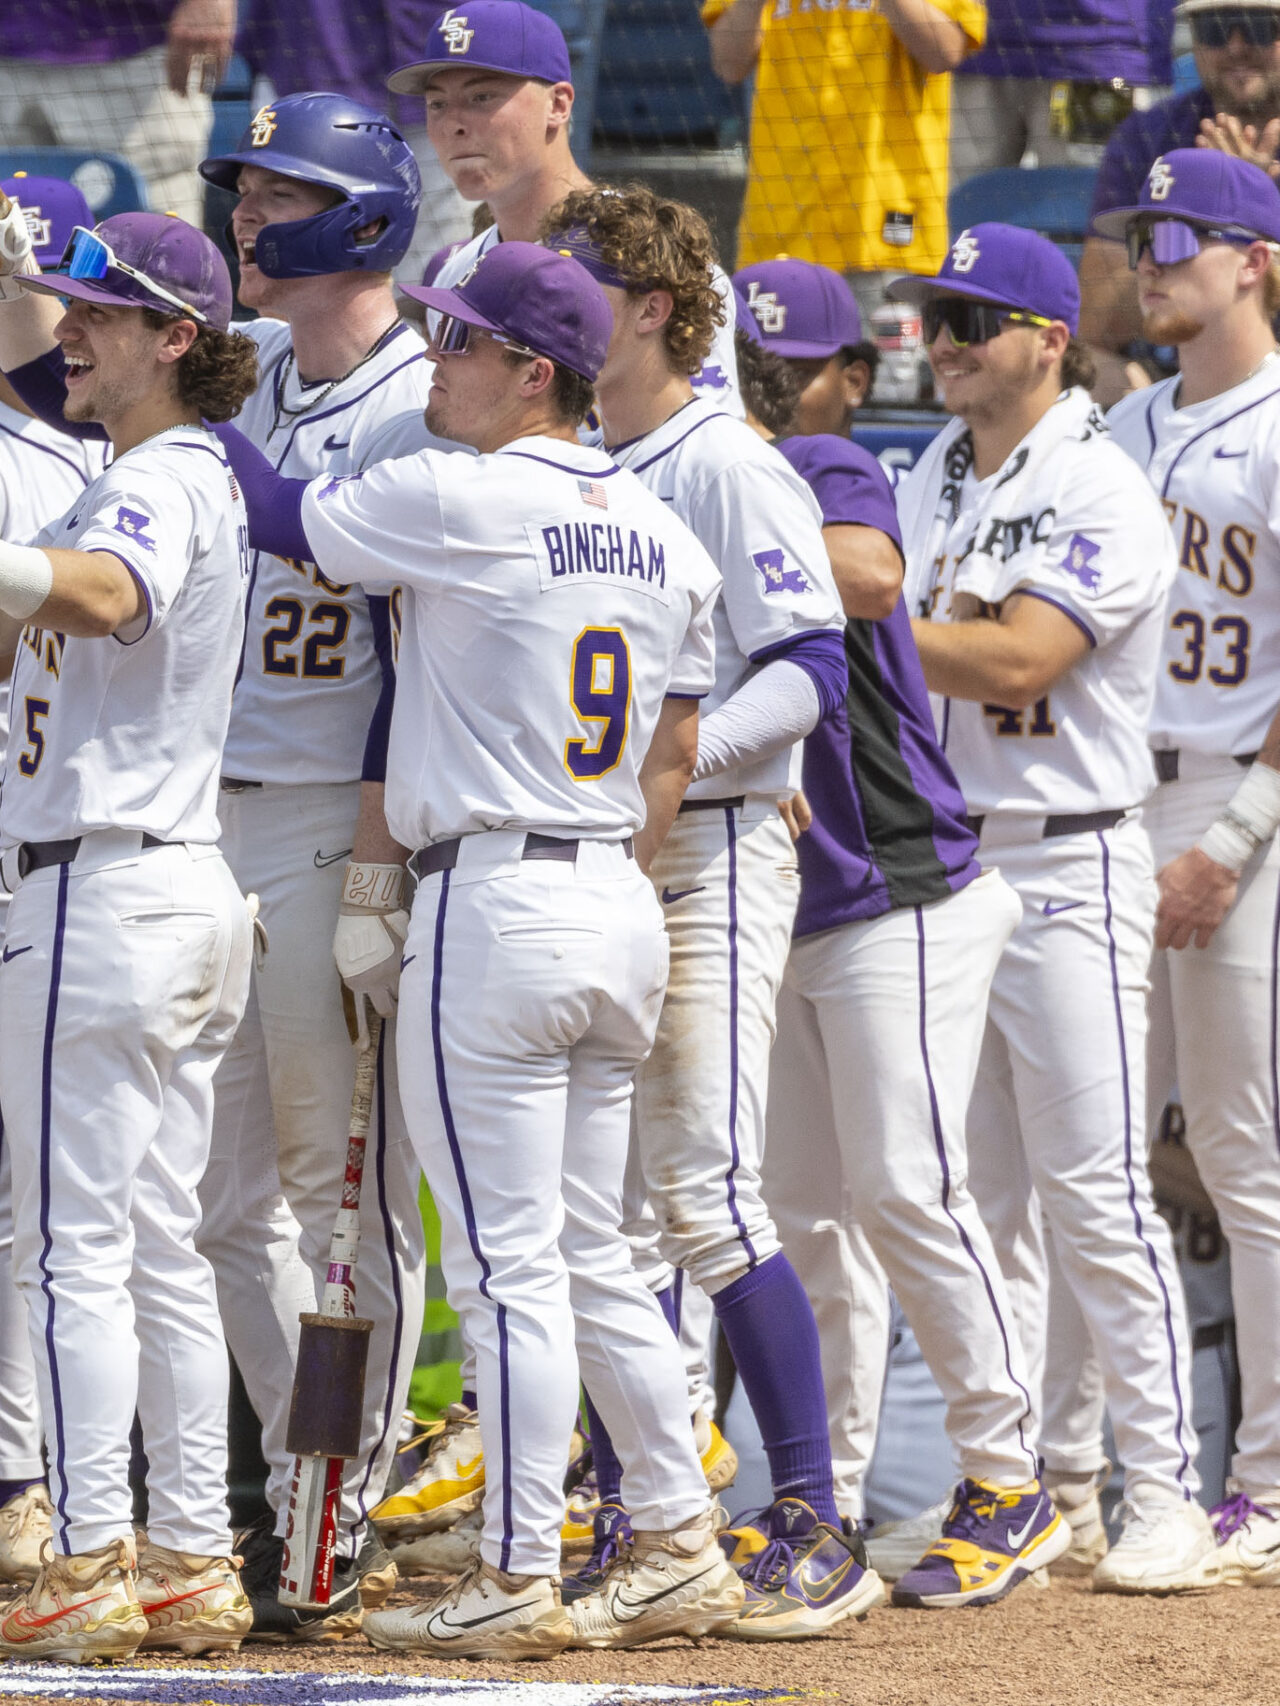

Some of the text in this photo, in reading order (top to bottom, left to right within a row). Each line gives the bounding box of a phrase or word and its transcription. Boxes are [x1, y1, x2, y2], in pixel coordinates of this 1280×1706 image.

[438, 9, 475, 55] LSU
[251, 105, 277, 147] LSU
[1150, 156, 1175, 200] LSU
[952, 229, 980, 272] LSU
[748, 282, 786, 333] LSU
[542, 521, 666, 590] BINGHAM
[262, 596, 352, 680] 22
[1169, 610, 1252, 688] 33
[563, 625, 633, 782] 9
[18, 695, 51, 779] 5
[321, 1529, 333, 1590] CONNECT
